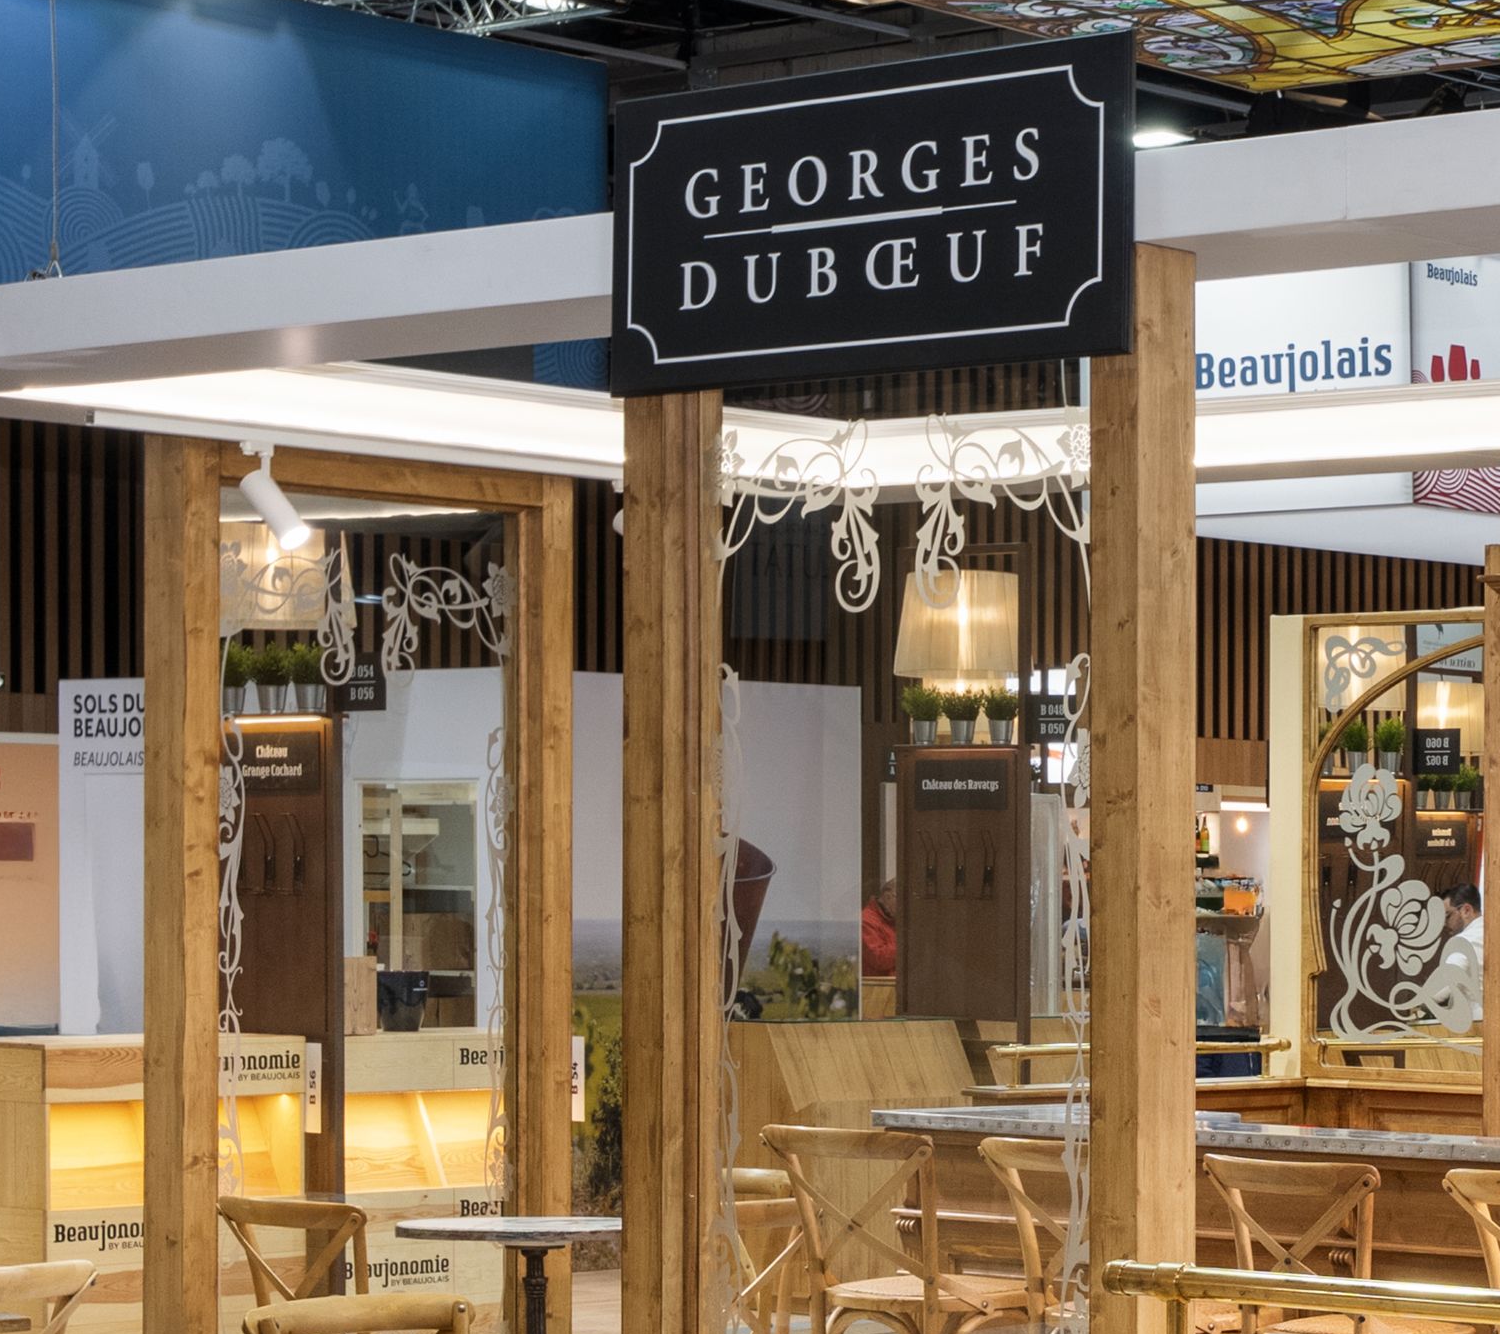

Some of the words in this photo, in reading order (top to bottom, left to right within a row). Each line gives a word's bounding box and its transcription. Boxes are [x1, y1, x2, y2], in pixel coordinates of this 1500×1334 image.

[684, 127, 1041, 219] GEORGES
[678, 222, 1045, 312] DUBŒUF
[1427, 263, 1478, 287] Beaujolais
[1196, 336, 1392, 394] Beaujolais
[73, 693, 118, 714] SOLS
[73, 716, 146, 738] BEAUJO
[73, 751, 146, 766] BEAUJOLAIS
[255, 745, 289, 758] Château
[242, 765, 270, 780] Grange
[271, 763, 303, 777] Cochard
[922, 778, 953, 790] Château
[953, 779, 967, 790] des
[968, 779, 999, 792] Ravatys
[250, 1071, 301, 1081] BEAUJOLAIS
[108, 1242, 119, 1250] BY
[402, 1275, 449, 1286] BEAUJOLAIS
